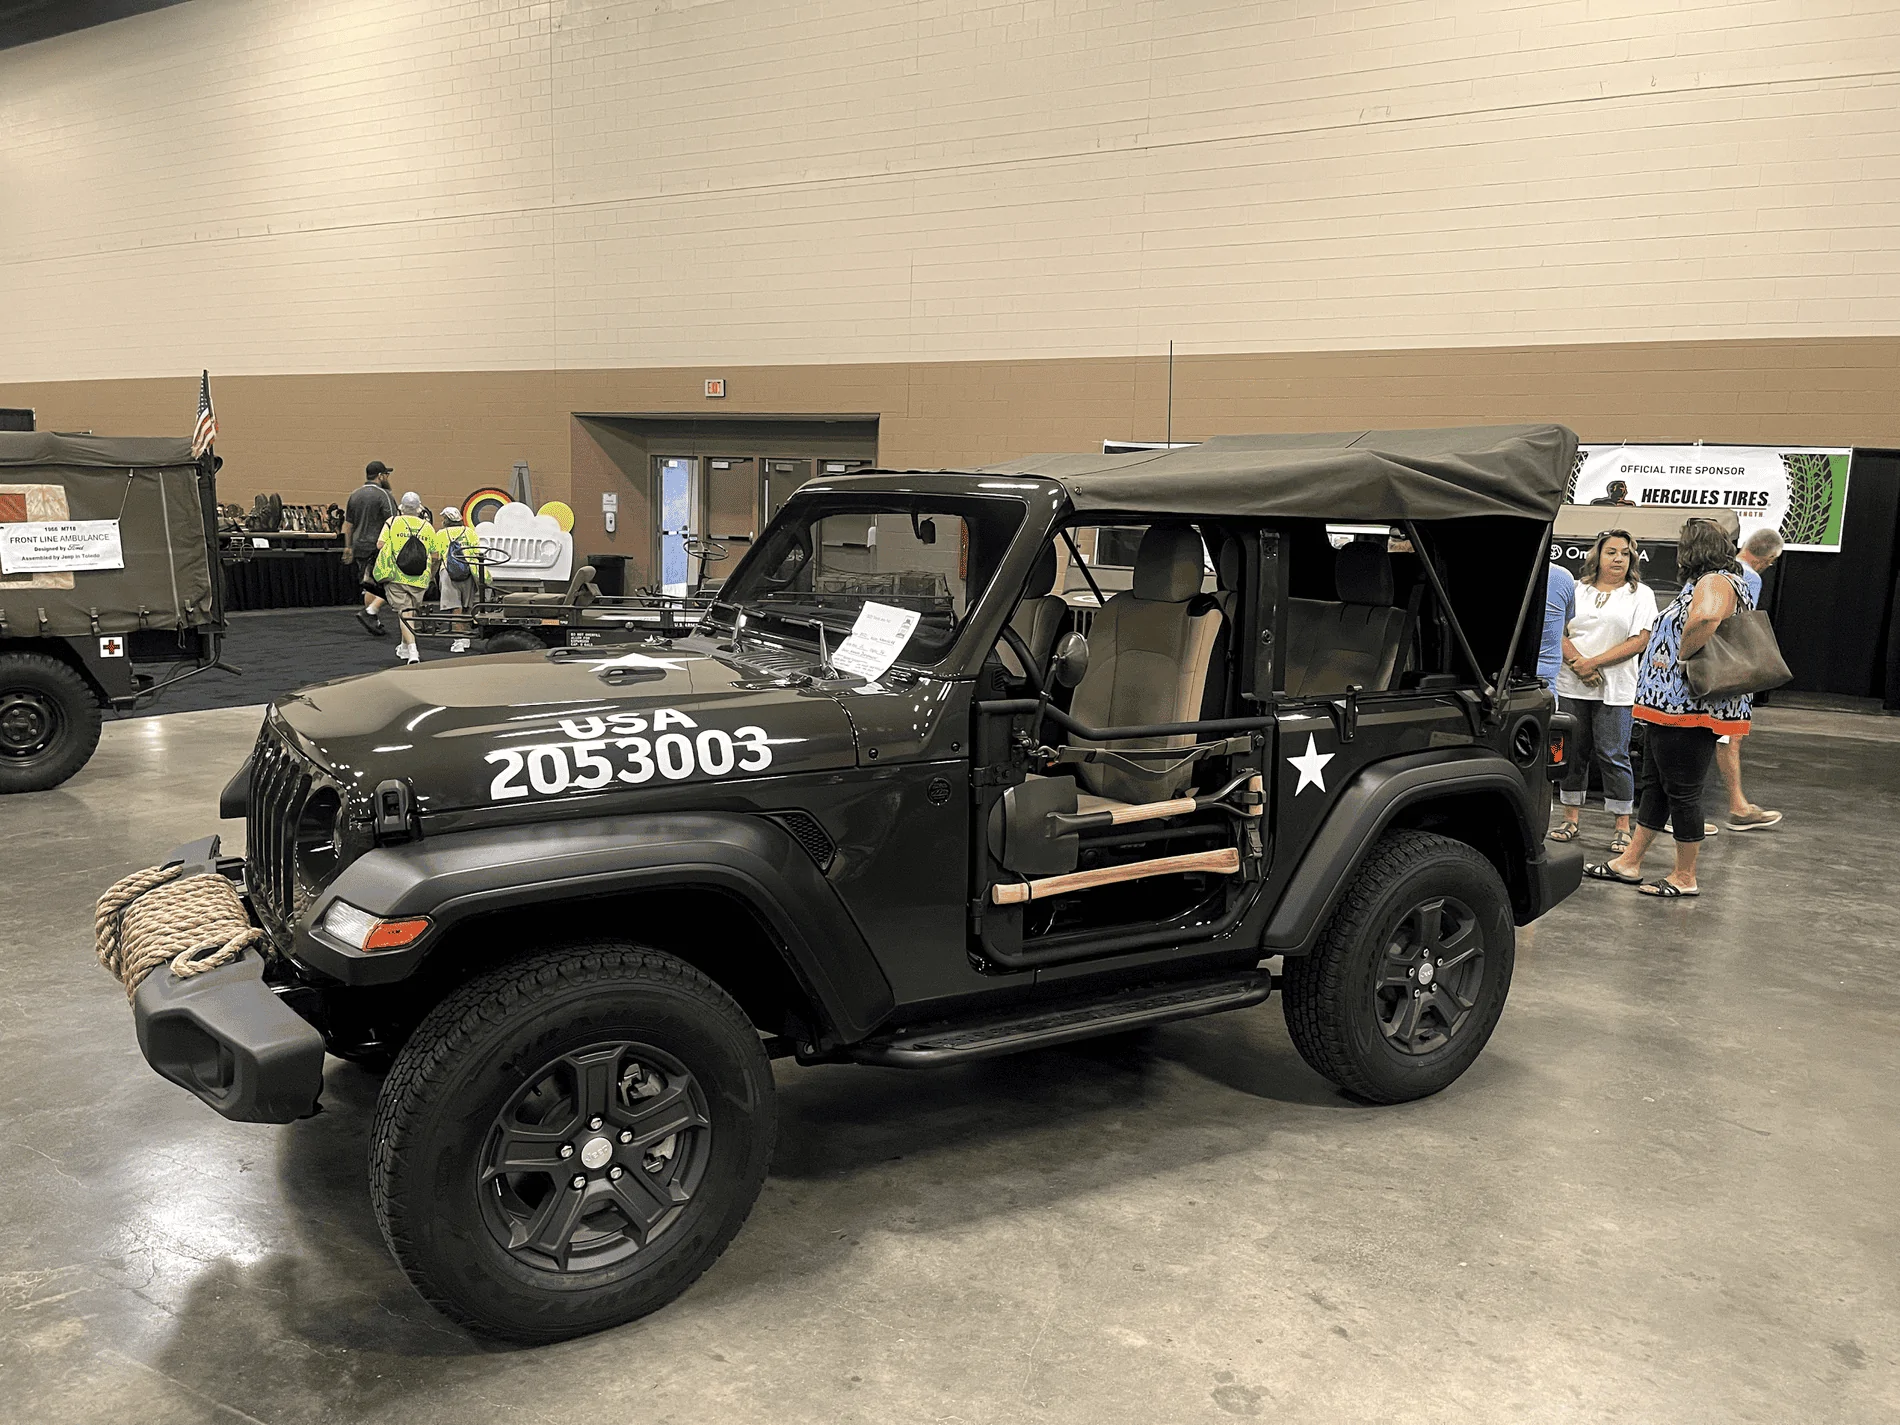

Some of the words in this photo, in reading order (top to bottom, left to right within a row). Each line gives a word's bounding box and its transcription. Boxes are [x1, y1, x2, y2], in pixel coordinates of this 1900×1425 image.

[1620, 464, 1666, 474] OFFICIAL
[1669, 466, 1692, 475] TIRE
[1694, 466, 1746, 476] SPONSOR
[1641, 488, 1720, 505] HERCULES
[1723, 490, 1769, 506] TIRES
[9, 536, 37, 544] FRONT
[39, 535, 58, 543] LINE
[60, 533, 110, 542] AMBULANCE
[558, 708, 698, 740] USA
[483, 725, 773, 800] 2053003
